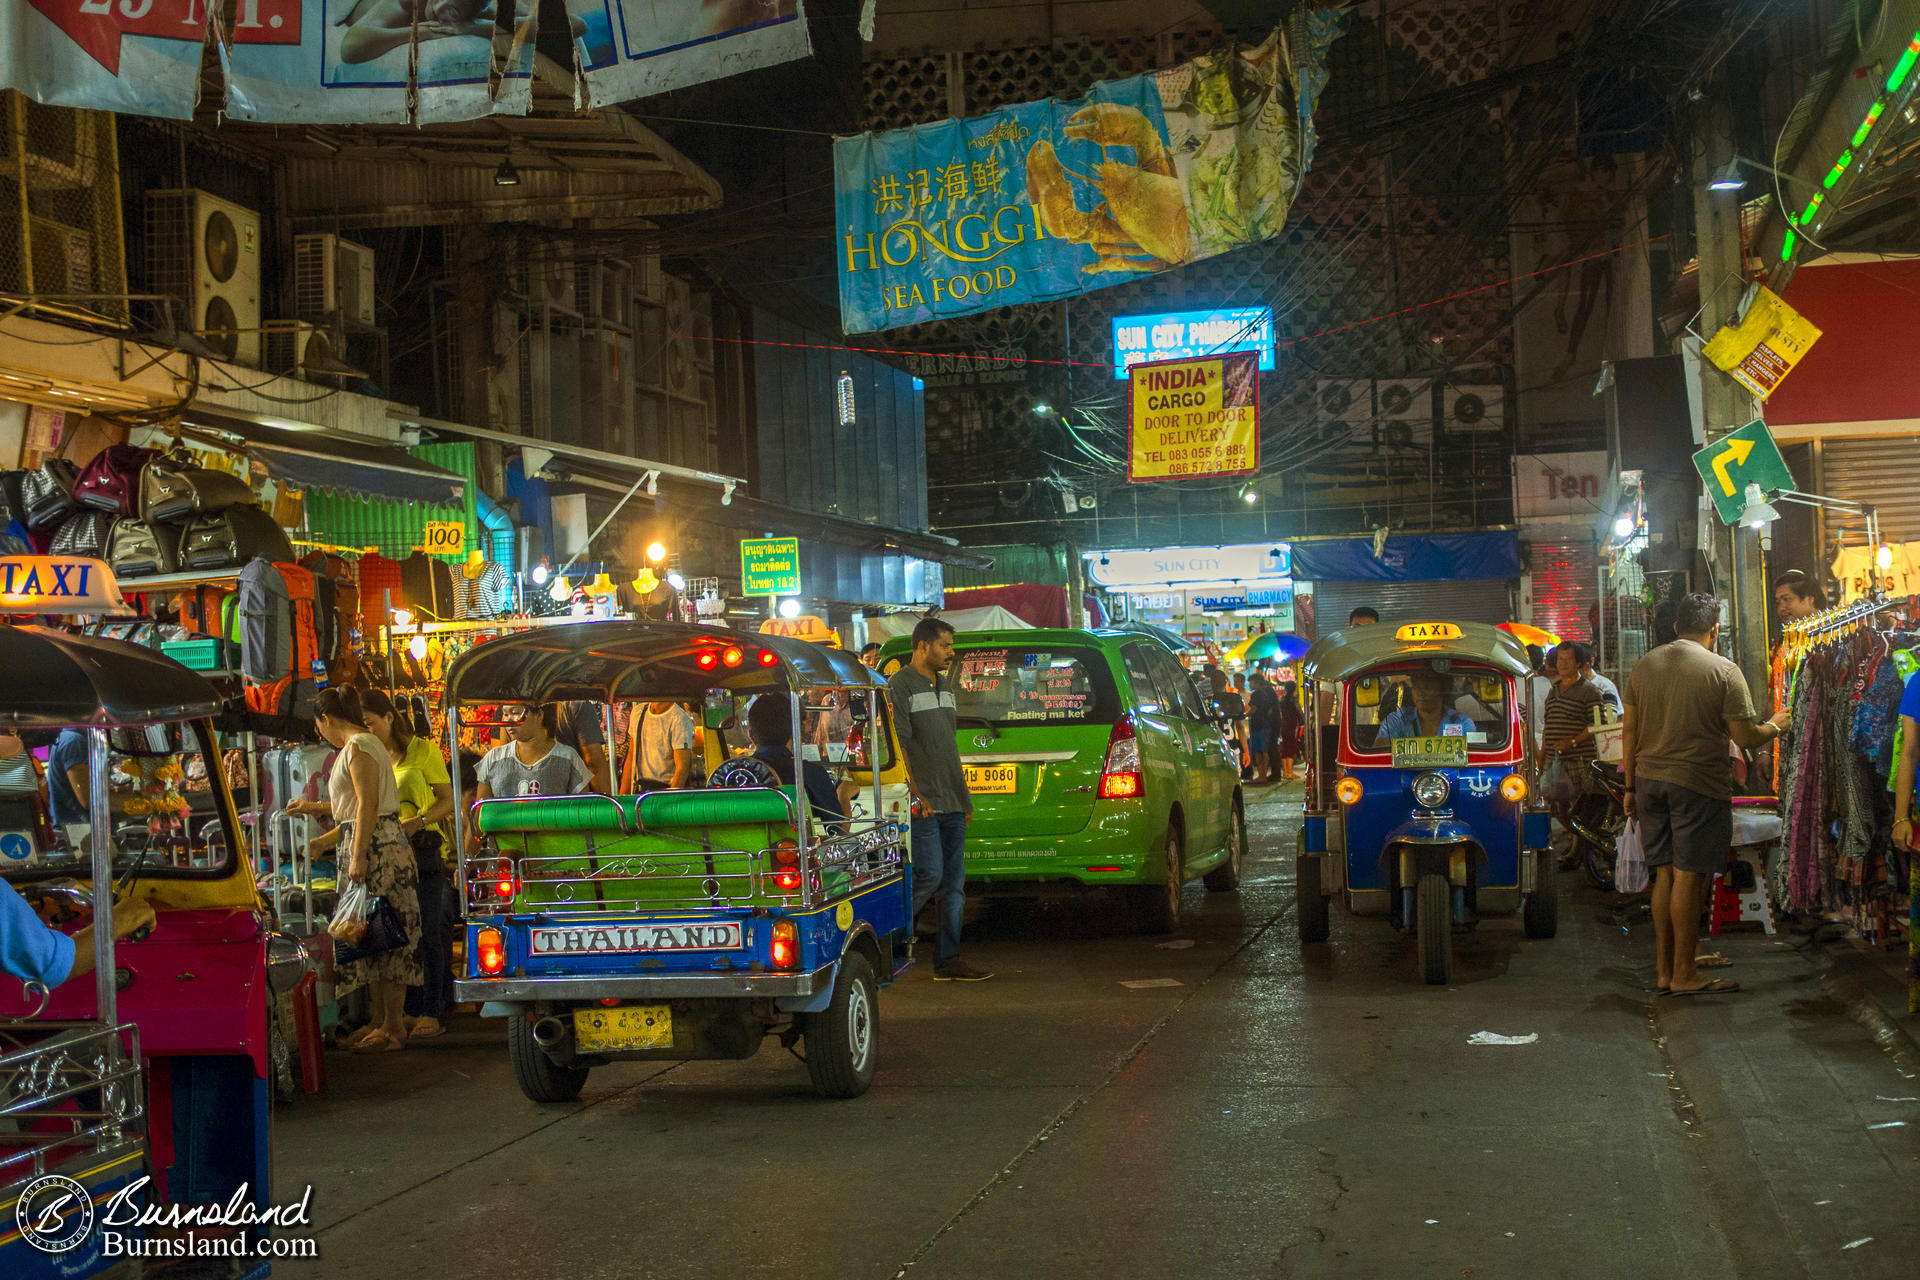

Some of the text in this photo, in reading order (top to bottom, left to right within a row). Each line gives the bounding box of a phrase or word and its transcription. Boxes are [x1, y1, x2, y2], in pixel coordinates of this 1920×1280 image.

[872, 156, 1002, 215] 洪记海鲜
[842, 203, 1048, 272] HONGGI
[883, 266, 1016, 312] SEA FOOD
[1117, 327, 1147, 350] SUN
[1151, 324, 1184, 348] CITY
[1148, 392, 1206, 410] CARGO
[1145, 408, 1246, 430] DOOR TO DOOR
[1160, 425, 1229, 446] DELIVERY
[1144, 452, 1166, 463] TEL
[1169, 450, 1188, 461] 083
[1191, 447, 1211, 458] 055
[1215, 446, 1222, 456] 6
[1169, 458, 1246, 474] 086 572 8 755
[1541, 469, 1598, 500] Ten
[428, 528, 460, 546] 100
[1154, 559, 1221, 572] SUN CITY
[0, 563, 92, 597] TAXI
[1195, 595, 1245, 607] SUN CITY
[1248, 589, 1292, 604] PHARMACY
[766, 619, 814, 637] TAXI
[1409, 625, 1448, 637] TAXI
[1024, 654, 1037, 667] GPS
[1008, 710, 1046, 721] Floating
[985, 769, 1014, 782] 9080
[541, 926, 731, 952] THAILAND
